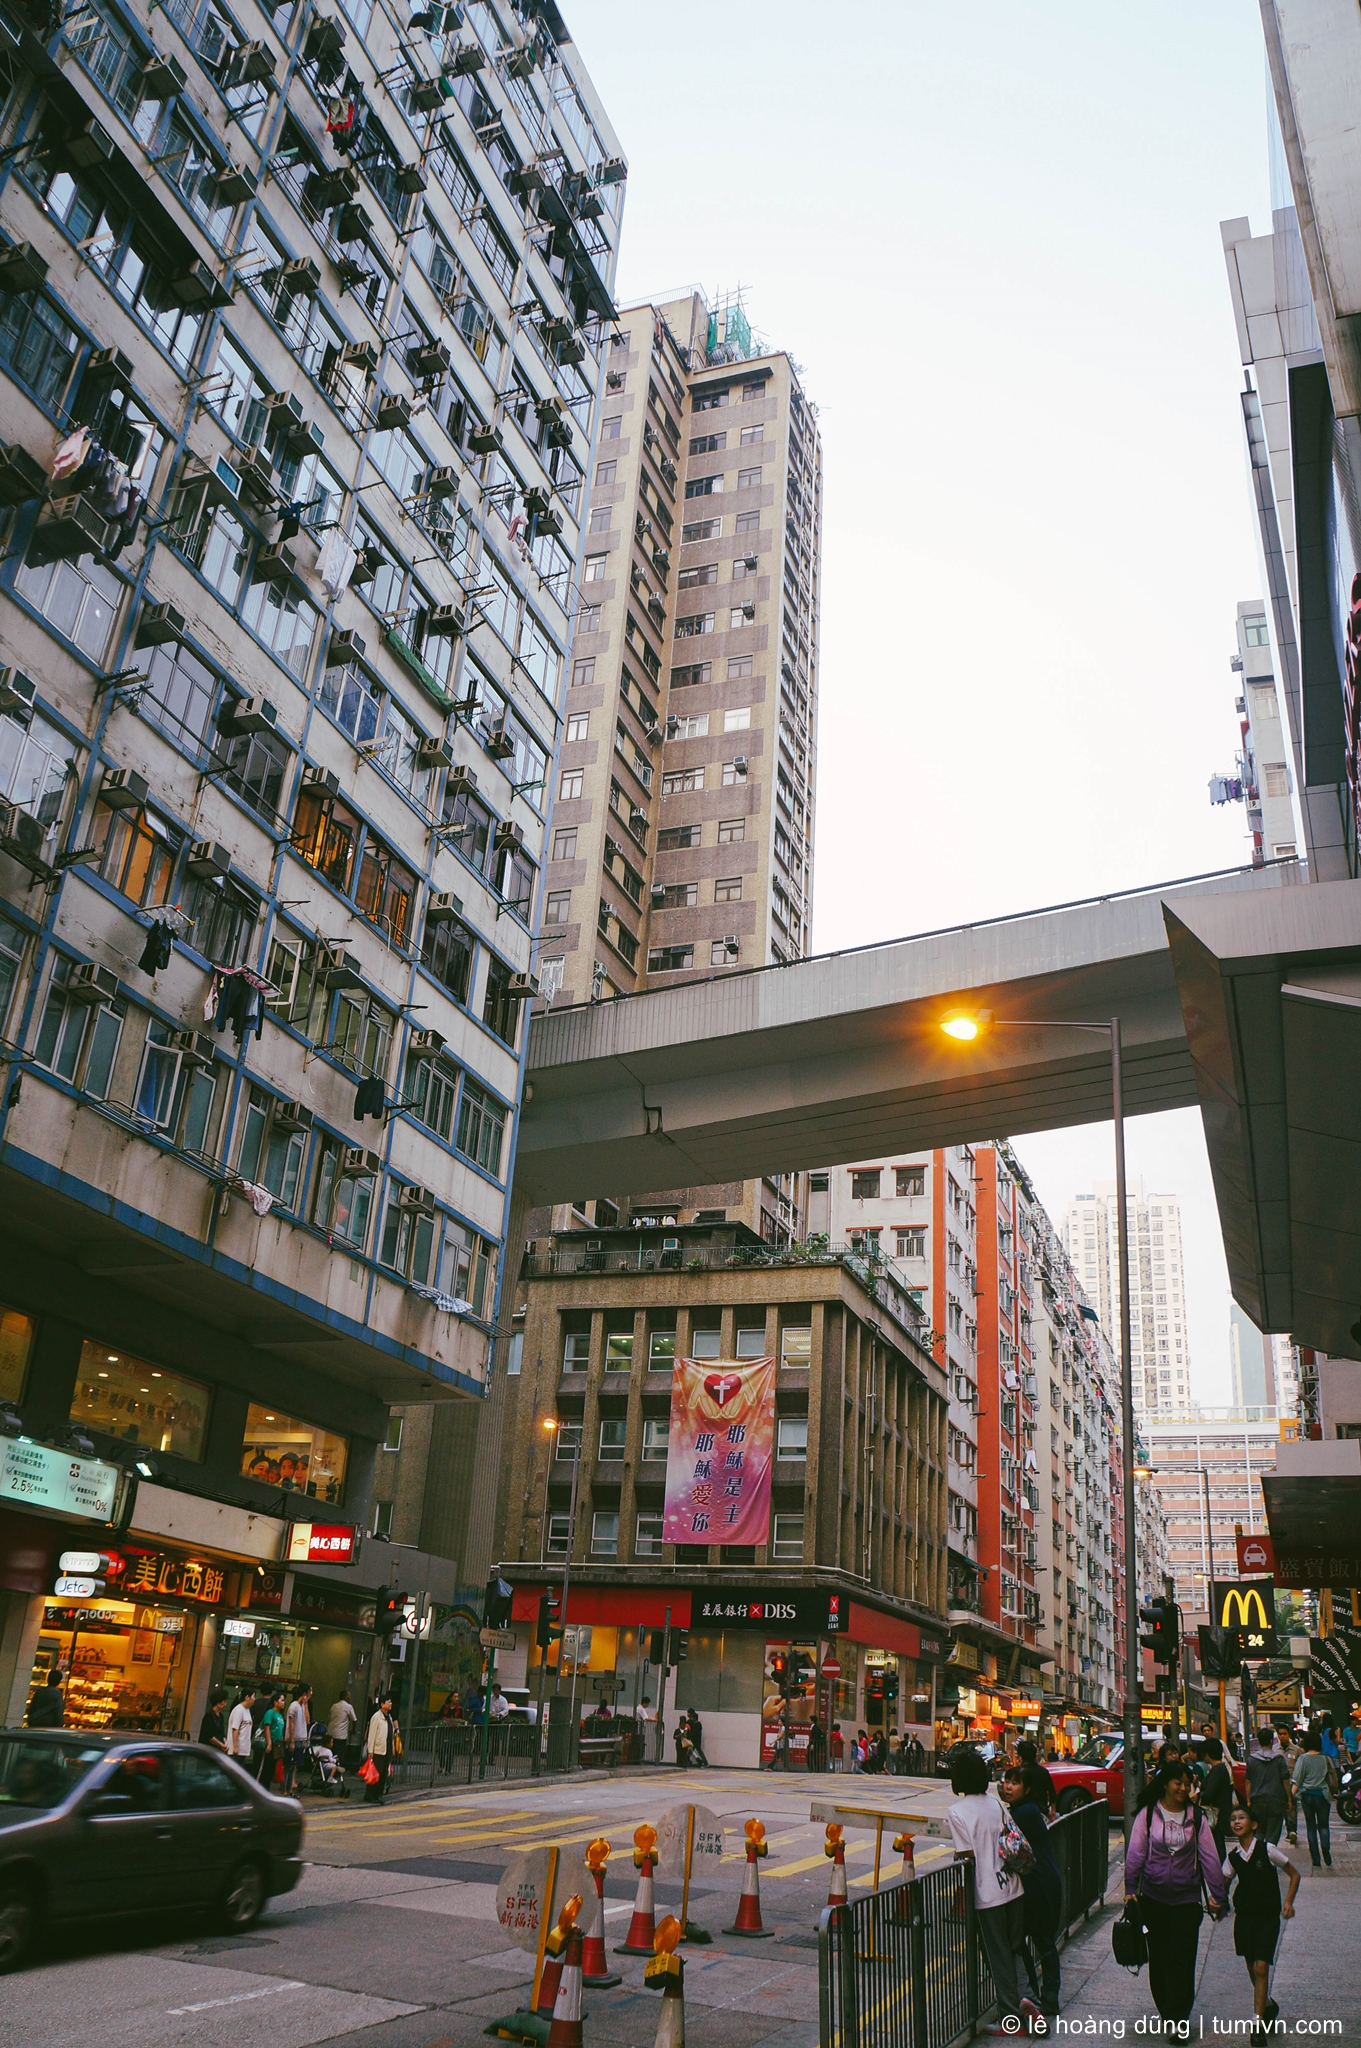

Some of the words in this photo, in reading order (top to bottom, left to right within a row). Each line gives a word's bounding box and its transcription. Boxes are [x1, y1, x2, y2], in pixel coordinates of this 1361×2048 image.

[722, 1424, 746, 1524] 耶穌是主
[11, 1477, 33, 1494] 2.5%
[691, 1433, 715, 1532] 耶穌愛你
[95, 1499, 107, 1512] 0%
[310, 1536, 351, 1551] 美心西餅
[135, 1555, 223, 1603] 美心西餅
[764, 1603, 796, 1618] DBS
[1248, 1634, 1265, 1647] 24
[812, 1815, 826, 1823] SFK
[699, 1832, 722, 1843] SFK
[506, 1896, 539, 1911] SFK
[500, 1911, 540, 1930] 新福港
